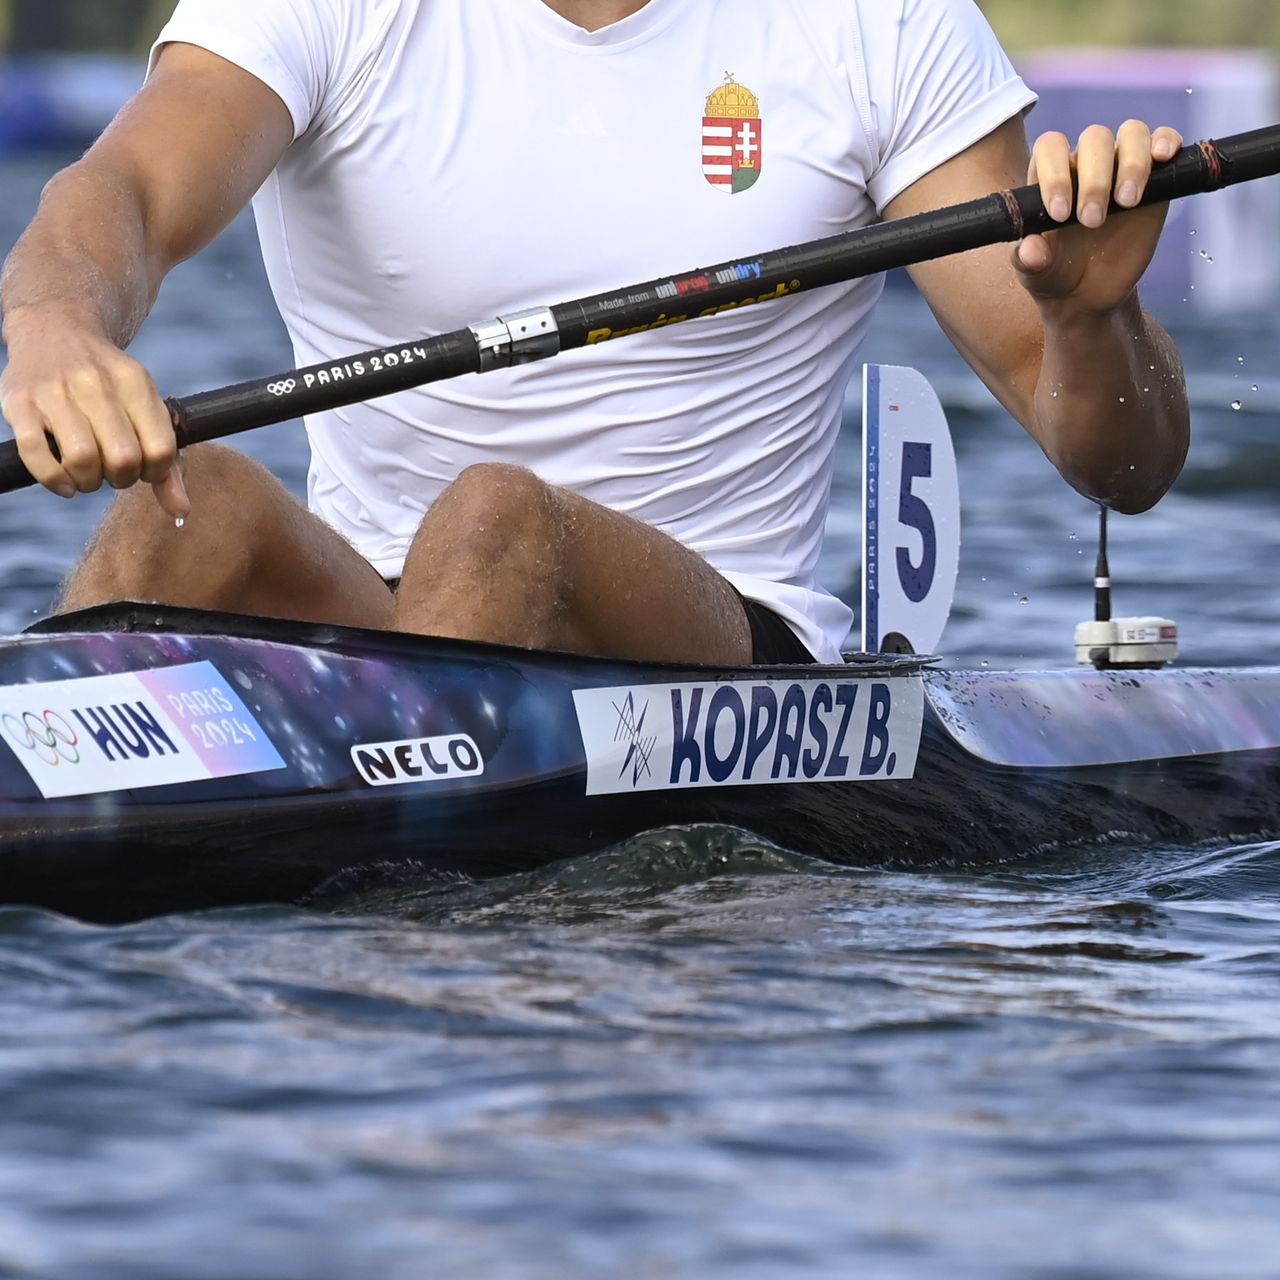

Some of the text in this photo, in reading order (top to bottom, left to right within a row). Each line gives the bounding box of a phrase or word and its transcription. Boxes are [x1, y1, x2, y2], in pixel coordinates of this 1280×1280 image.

[598, 297, 625, 312] Made
[627, 291, 650, 305] from
[303, 347, 426, 388] PARIS 2024
[895, 441, 937, 603] 5
[70, 701, 180, 762] HUN
[191, 717, 257, 749] 2024
[669, 683, 897, 784] KOPASZ B.
[356, 738, 479, 781] NELO
